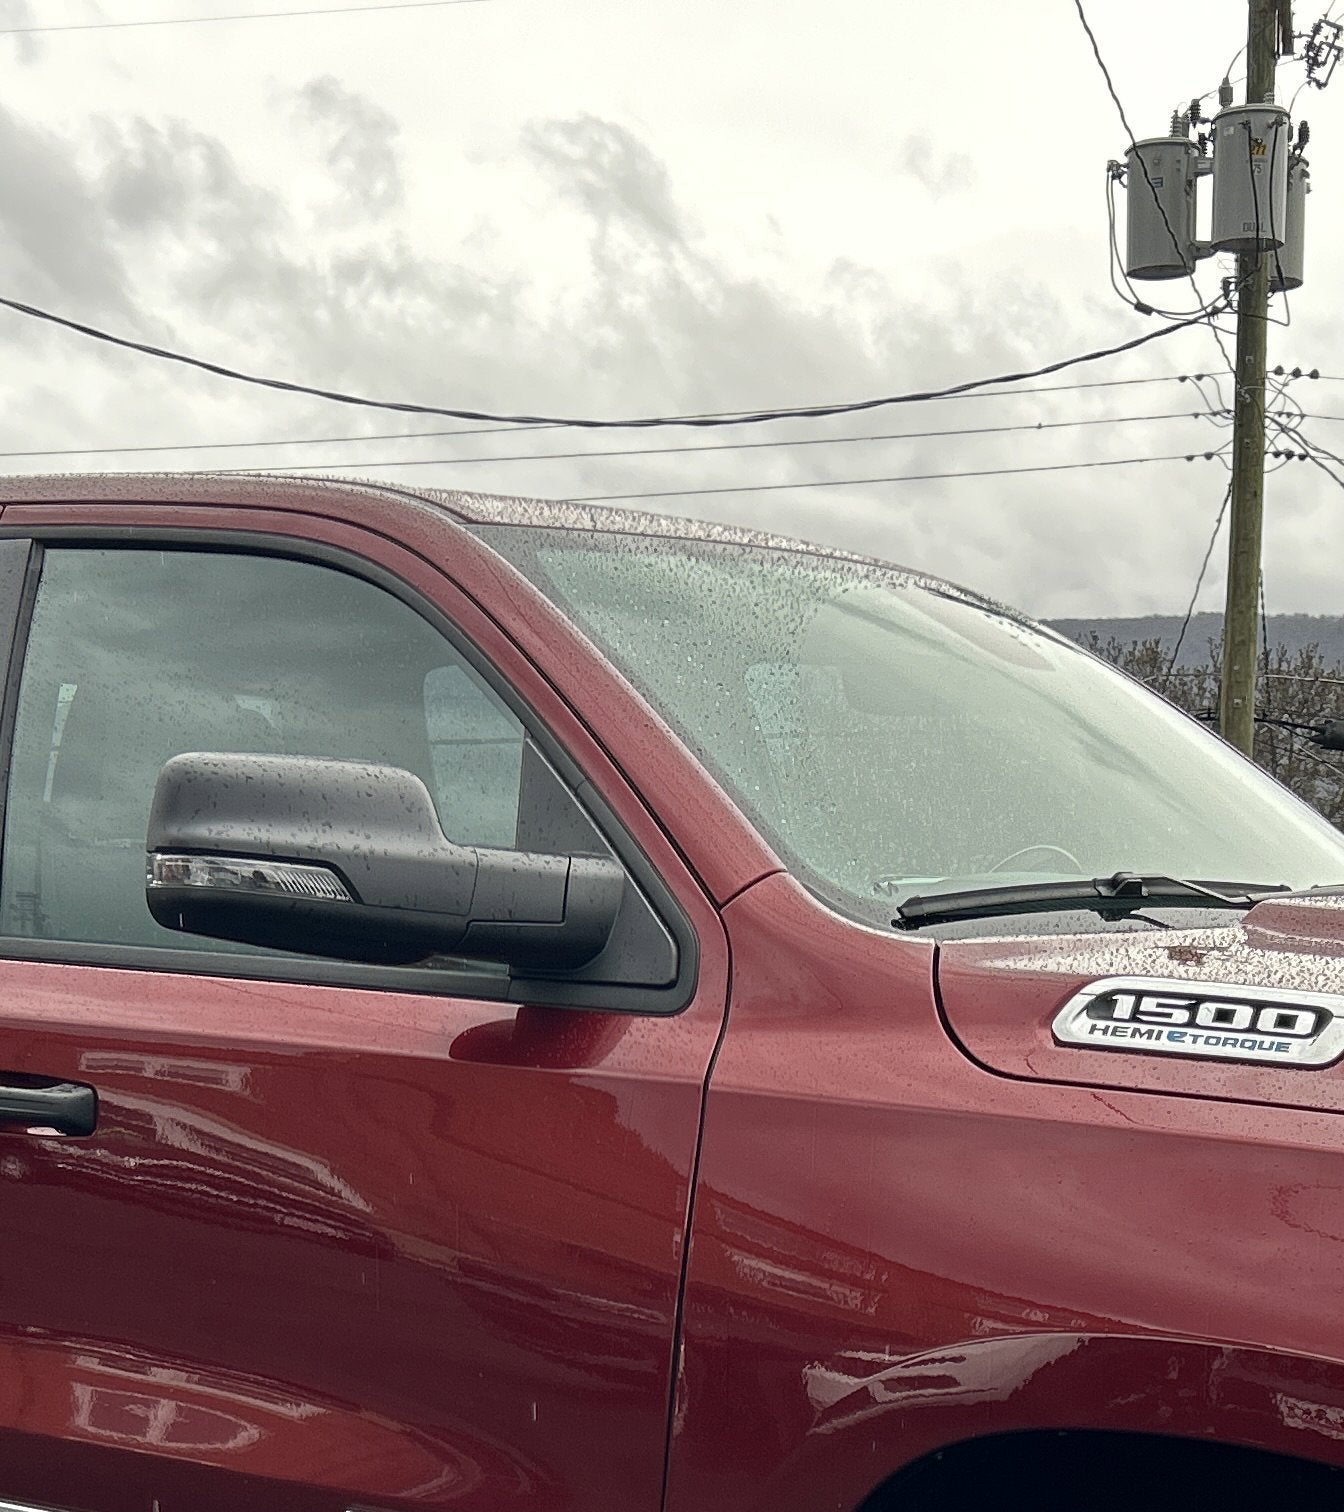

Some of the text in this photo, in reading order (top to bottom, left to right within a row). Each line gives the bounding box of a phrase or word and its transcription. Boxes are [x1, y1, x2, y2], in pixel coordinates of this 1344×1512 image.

[1242, 222, 1267, 233] DUL
[1110, 993, 1318, 1036] 1500
[1088, 1023, 1162, 1041] HEMI
